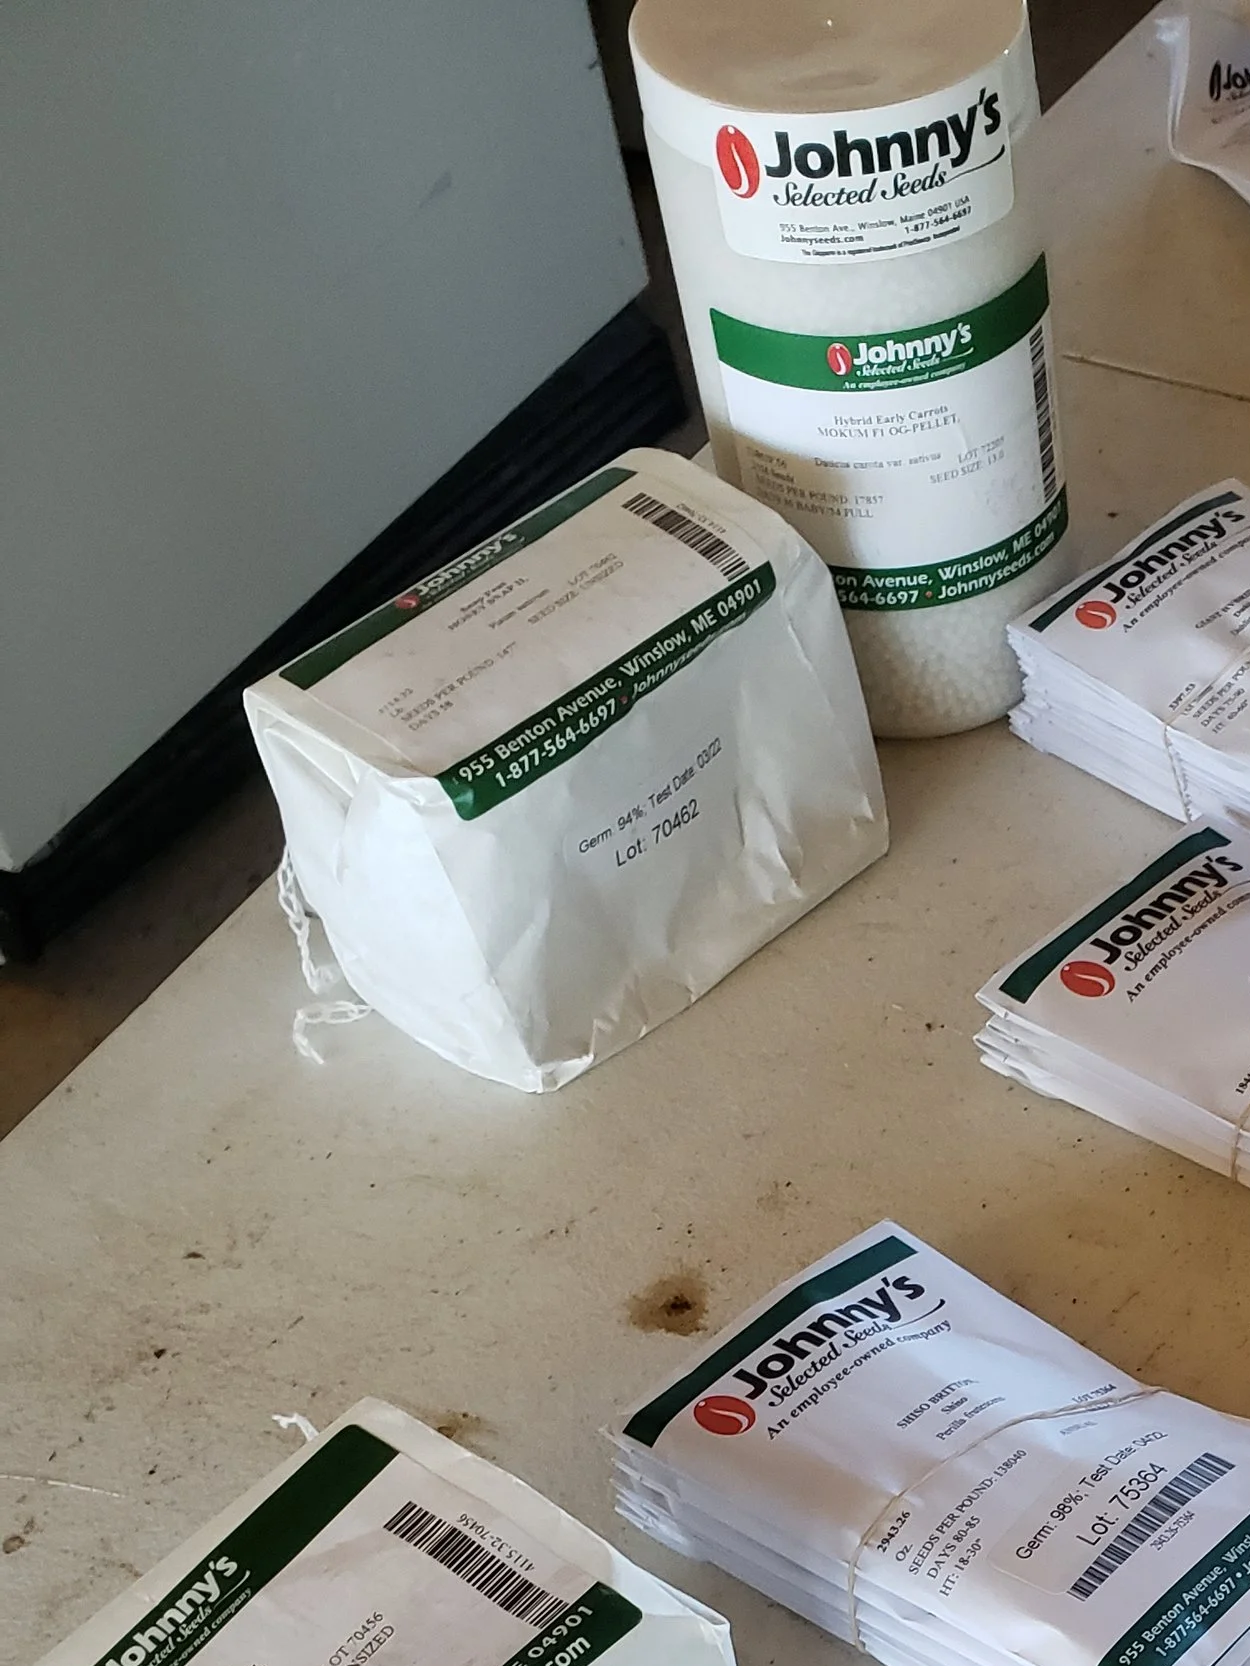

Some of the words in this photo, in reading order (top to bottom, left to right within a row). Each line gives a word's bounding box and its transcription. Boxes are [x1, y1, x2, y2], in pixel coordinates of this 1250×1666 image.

[764, 88, 1001, 179] Johnny's
[773, 178, 878, 206] Selected
[881, 162, 947, 201] Seeds
[853, 322, 972, 365] Johnny's
[834, 416, 872, 427] Hybrid
[876, 414, 905, 425] Early
[908, 405, 948, 420] Carrots
[412, 530, 521, 598] Johnny's
[862, 573, 933, 588] Avenue,
[938, 549, 1009, 581] Winslow,
[1013, 533, 1032, 553] ME
[938, 532, 1055, 600] Johnnyseeds.com
[1103, 509, 1246, 603] Johnny's
[455, 752, 498, 783] 955
[491, 713, 558, 760] Benton
[549, 671, 623, 722] Avenue,
[616, 626, 695, 681] Winslow,
[685, 609, 720, 634] ME
[711, 578, 769, 617] 04901
[490, 696, 624, 789] 1-877-564-6697
[648, 785, 672, 808] Test
[697, 738, 722, 768] 03/22
[652, 799, 700, 843] 70462
[1089, 855, 1243, 965] Johnny's
[732, 1274, 930, 1400] Johnny's
[895, 1401, 932, 1429] SHISO
[874, 1509, 913, 1552] 2943.26
[904, 1533, 942, 1575] SEEDS
[934, 1511, 961, 1535] PER
[953, 1474, 999, 1513] POUND:
[991, 1448, 1029, 1477] 138040
[1012, 1519, 1058, 1560] Germ:
[1046, 1488, 1091, 1522] 98%;
[1076, 1462, 1115, 1490] Test
[1075, 1508, 1120, 1546] Lot:
[1108, 1460, 1169, 1511] 75364
[452, 1511, 541, 1573] 4115.32-70456
[922, 1542, 960, 1579] DAYS
[950, 1514, 983, 1544] 80-85
[344, 1609, 387, 1647] 70456
[524, 1600, 594, 1664] 04901
[1151, 1577, 1241, 1655] 1-877-564-6697
